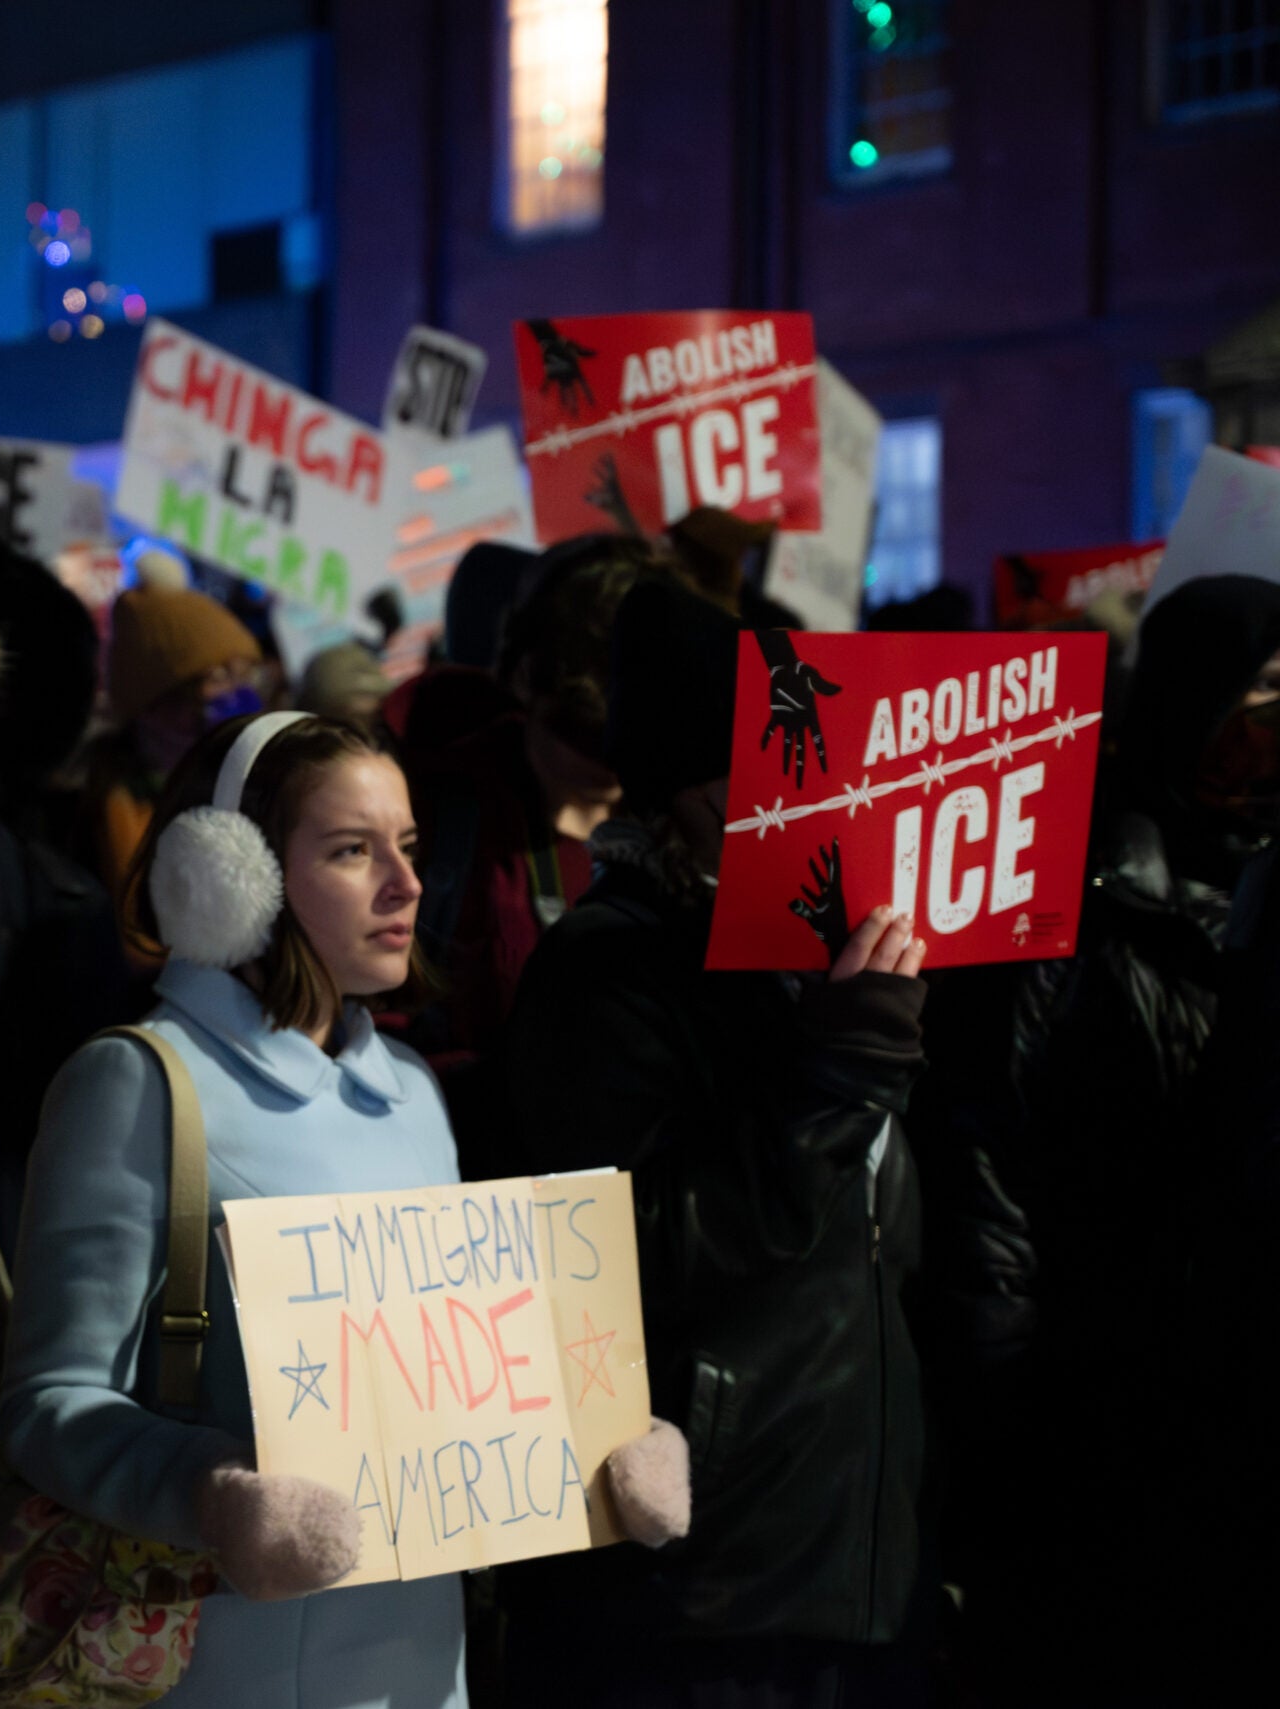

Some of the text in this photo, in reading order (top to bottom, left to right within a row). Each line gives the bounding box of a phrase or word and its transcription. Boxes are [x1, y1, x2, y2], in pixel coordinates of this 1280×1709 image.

[138, 336, 388, 506] CHINGA
[621, 319, 777, 405] ABOLISH
[219, 446, 298, 526] LA
[654, 394, 784, 526] ICE
[156, 480, 350, 618] MIGRA
[863, 646, 1058, 767] ABOLISH
[892, 761, 1045, 948] ICE
[278, 1195, 601, 1304] IMMIGRANTS
[340, 1288, 552, 1432] MADE
[352, 1432, 593, 1546] AMERICA
